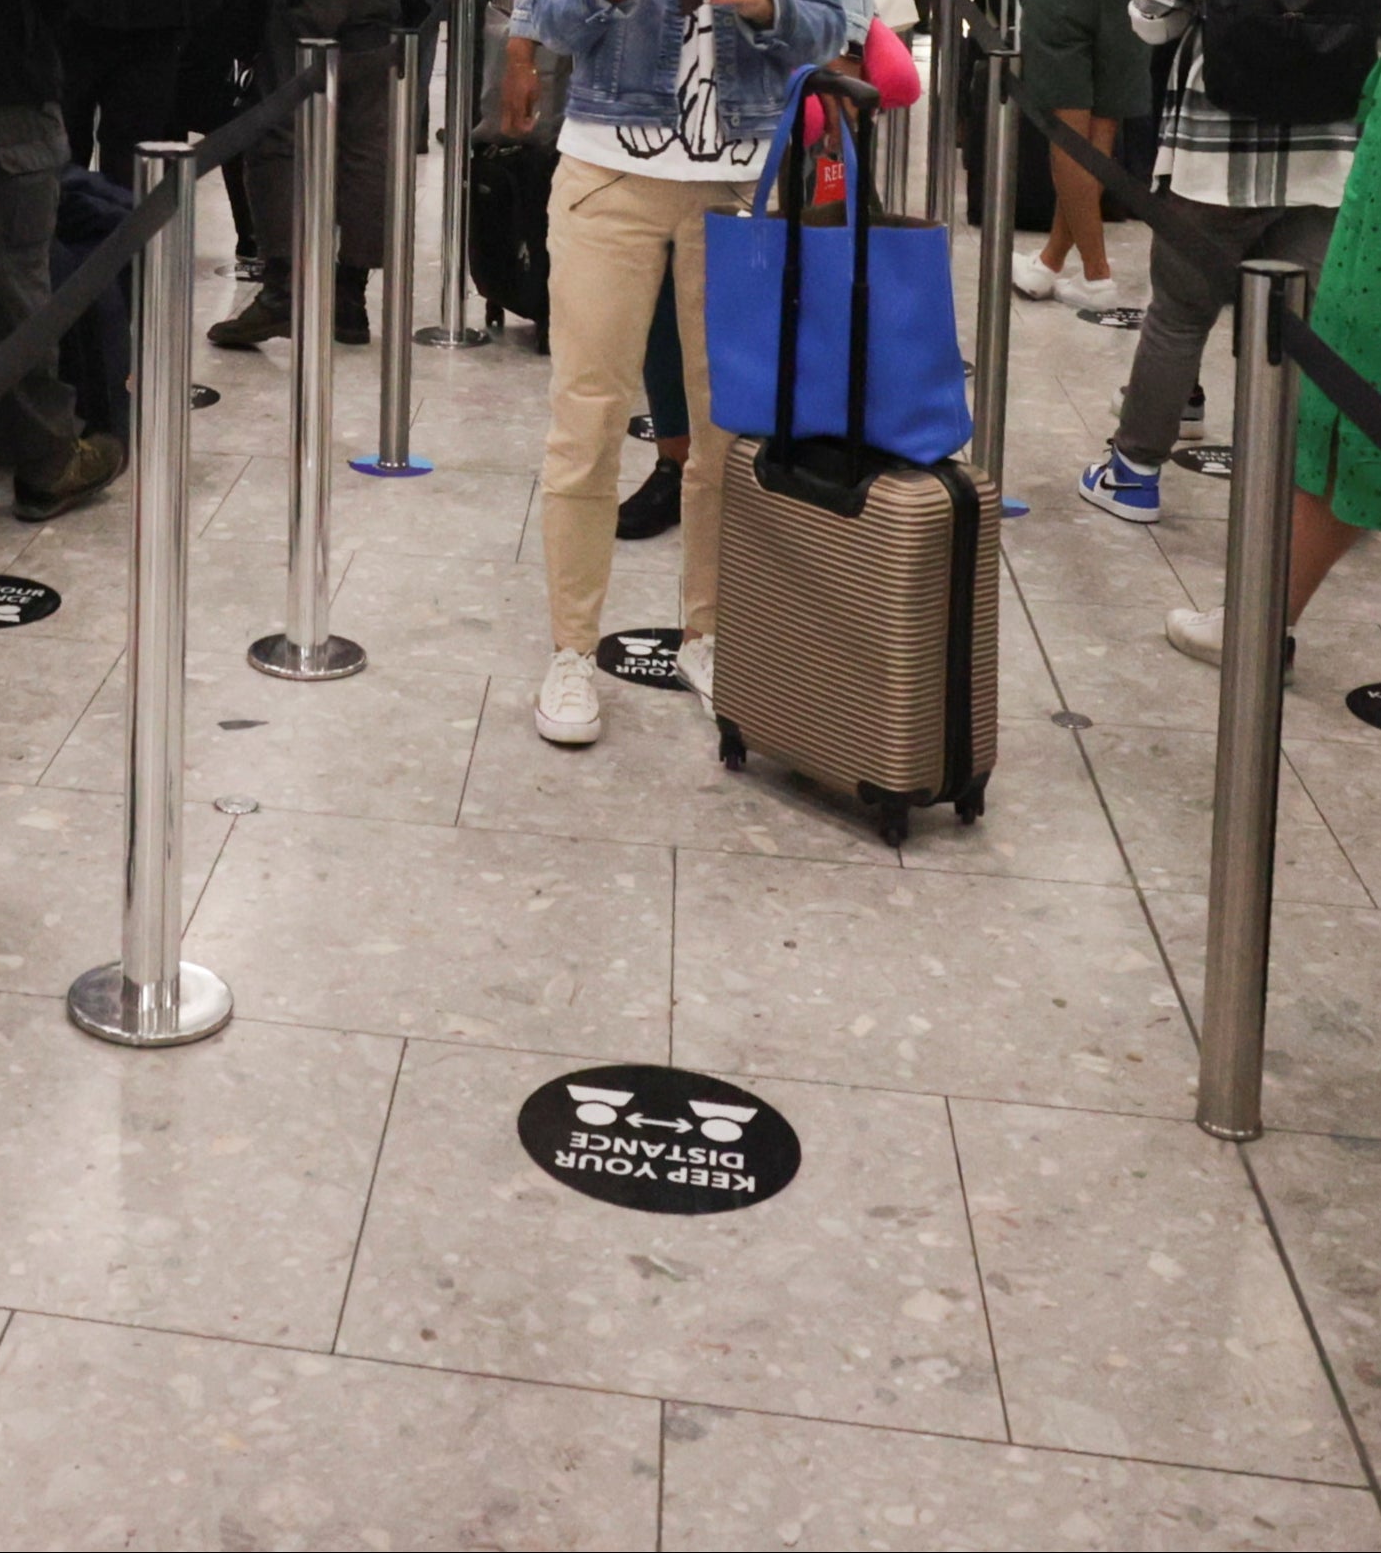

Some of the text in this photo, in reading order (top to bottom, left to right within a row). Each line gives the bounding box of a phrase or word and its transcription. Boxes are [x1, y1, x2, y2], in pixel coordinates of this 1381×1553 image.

[554, 1149, 757, 1193] KEEP YOUR
[569, 1130, 745, 1171] DISTANCE
